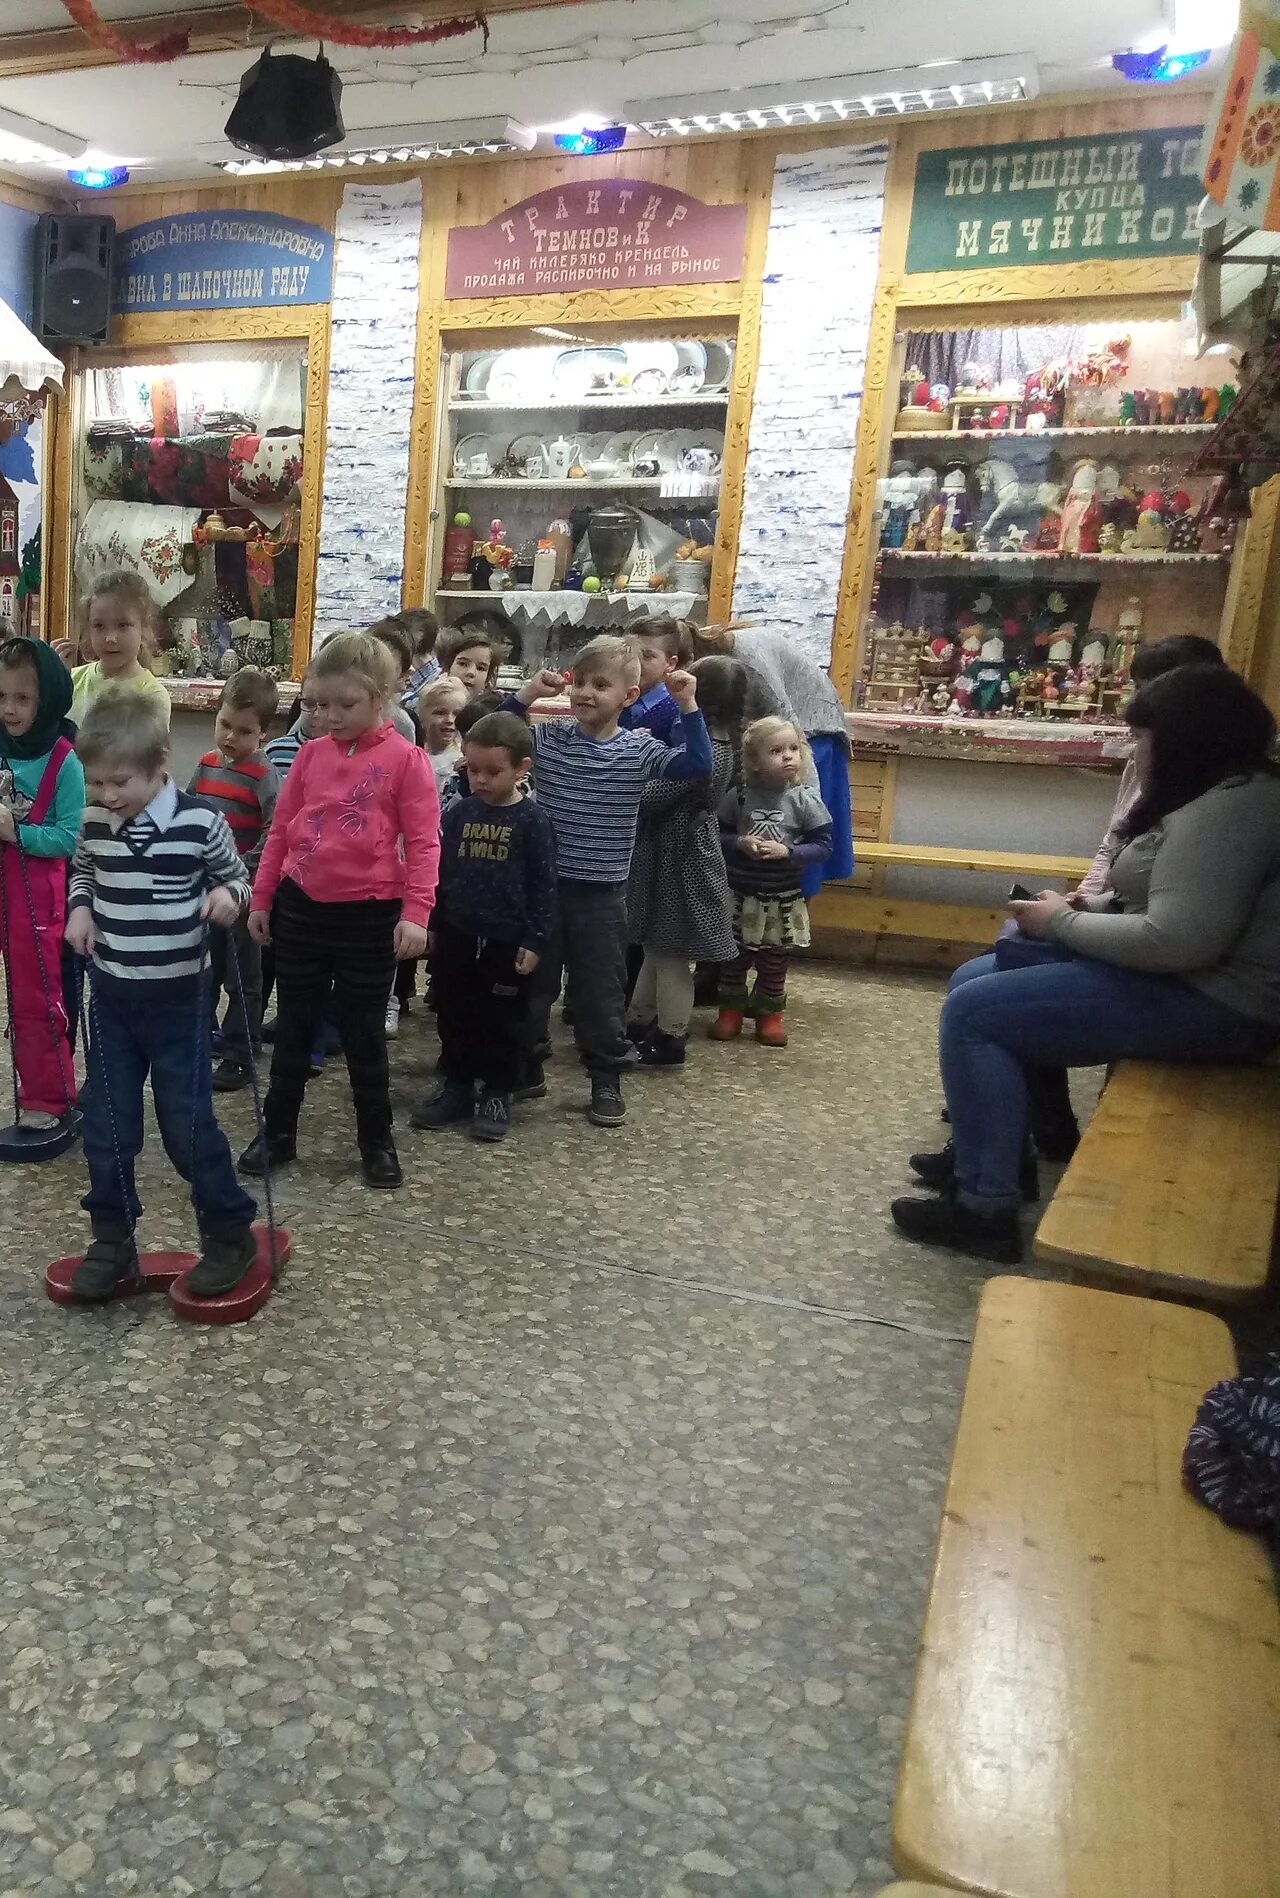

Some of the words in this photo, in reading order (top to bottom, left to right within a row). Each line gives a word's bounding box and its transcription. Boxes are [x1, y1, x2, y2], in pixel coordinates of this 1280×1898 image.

[944, 142, 1142, 196] ПОТЕШНЫЙ
[1162, 138, 1200, 178] ТО
[1056, 184, 1145, 211] КУПЦА
[500, 190, 688, 244] ТРАКТИР
[533, 227, 619, 253] ТЕМНОВ
[635, 221, 651, 246] К
[464, 272, 525, 288] ПРОДАЖА
[535, 267, 619, 284] РАСПИВОЧНО
[628, 265, 637, 278] И
[645, 263, 662, 276] НА
[672, 258, 721, 274] ВЫНОС
[494, 256, 521, 271] ЧАЙ
[615, 245, 689, 263] КРЕНДЕЛЬ
[162, 273, 172, 301] В
[177, 268, 264, 301] ШАПОЧНОМ
[271, 265, 310, 297] РЯДУ
[463, 823, 512, 842] BRAVE
[470, 842, 508, 861] WILD
